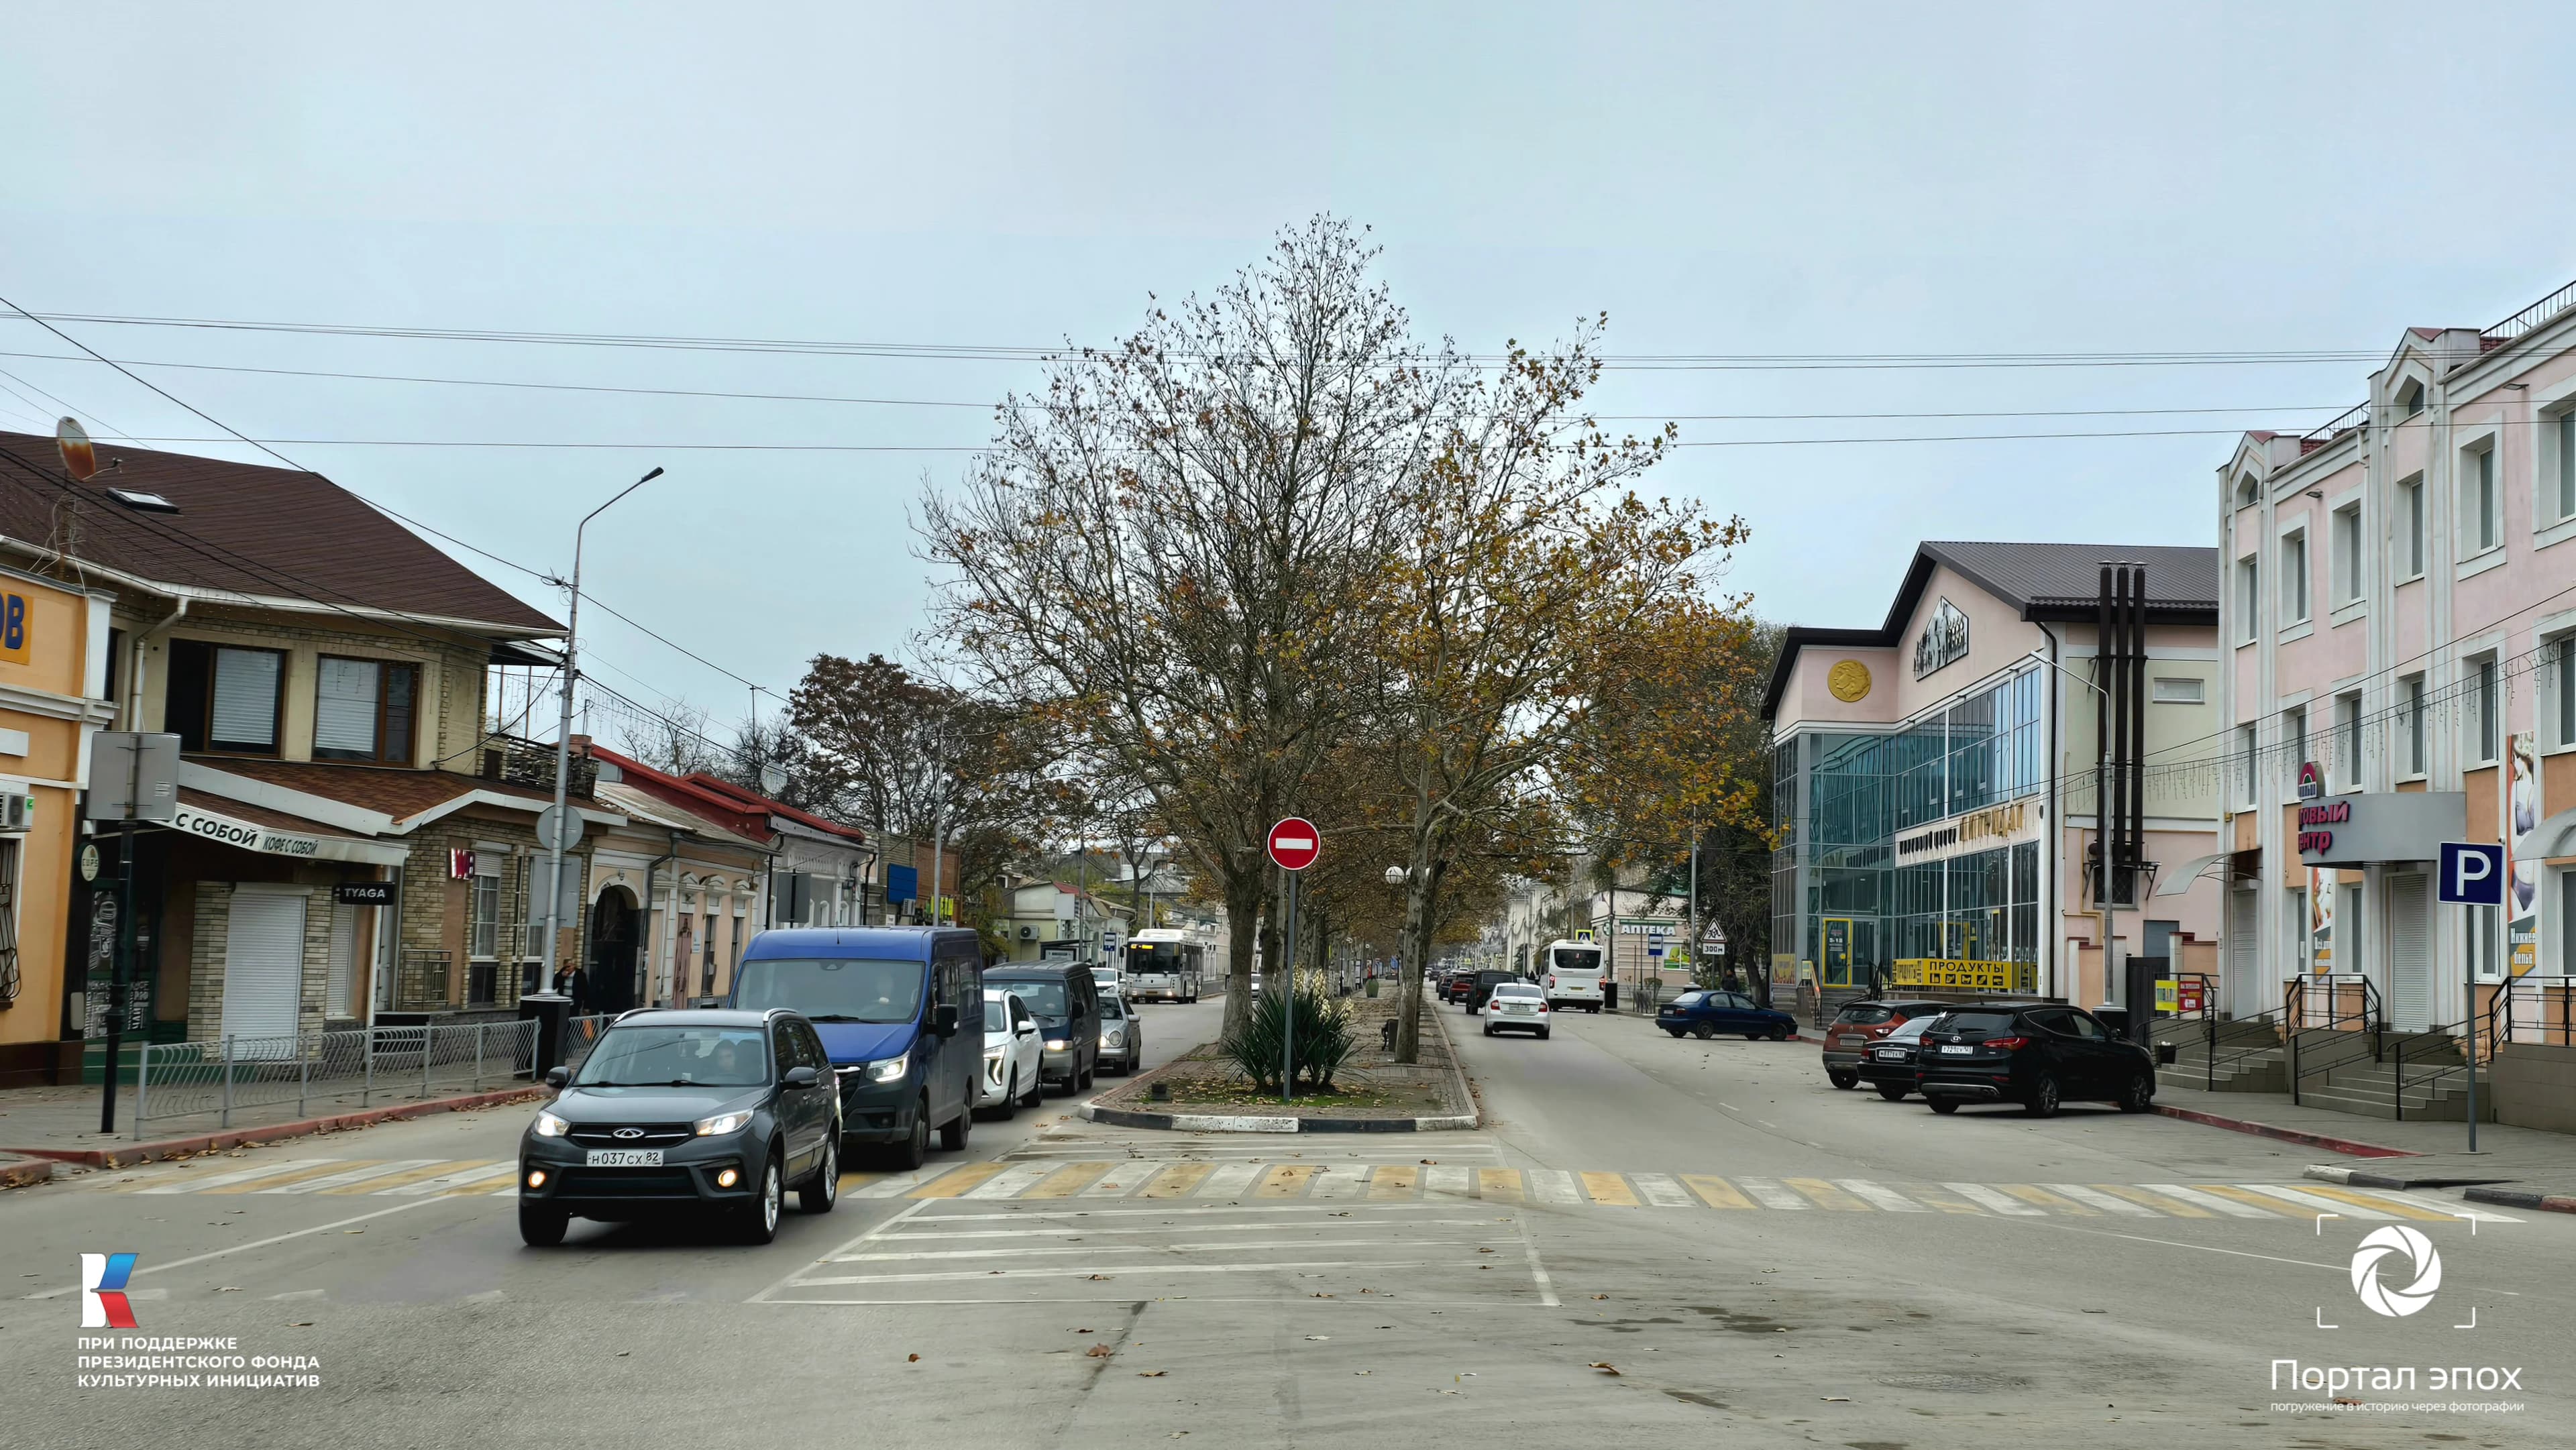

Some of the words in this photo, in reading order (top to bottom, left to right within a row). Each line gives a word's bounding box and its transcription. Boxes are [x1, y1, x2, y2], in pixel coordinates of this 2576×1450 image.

[0, 592, 25, 650] В
[176, 813, 189, 828] С
[192, 817, 258, 847] СОБОЙ
[262, 836, 285, 852] КОФЕ
[284, 839, 291, 852] С
[291, 840, 319, 856] СОБОЙ
[2300, 831, 2332, 856] ентр
[2457, 850, 2491, 896] P
[344, 888, 385, 898] TYAGA
[1621, 924, 1676, 936] АПТЕКА
[1929, 961, 2004, 973] ПРОДУКТЫ
